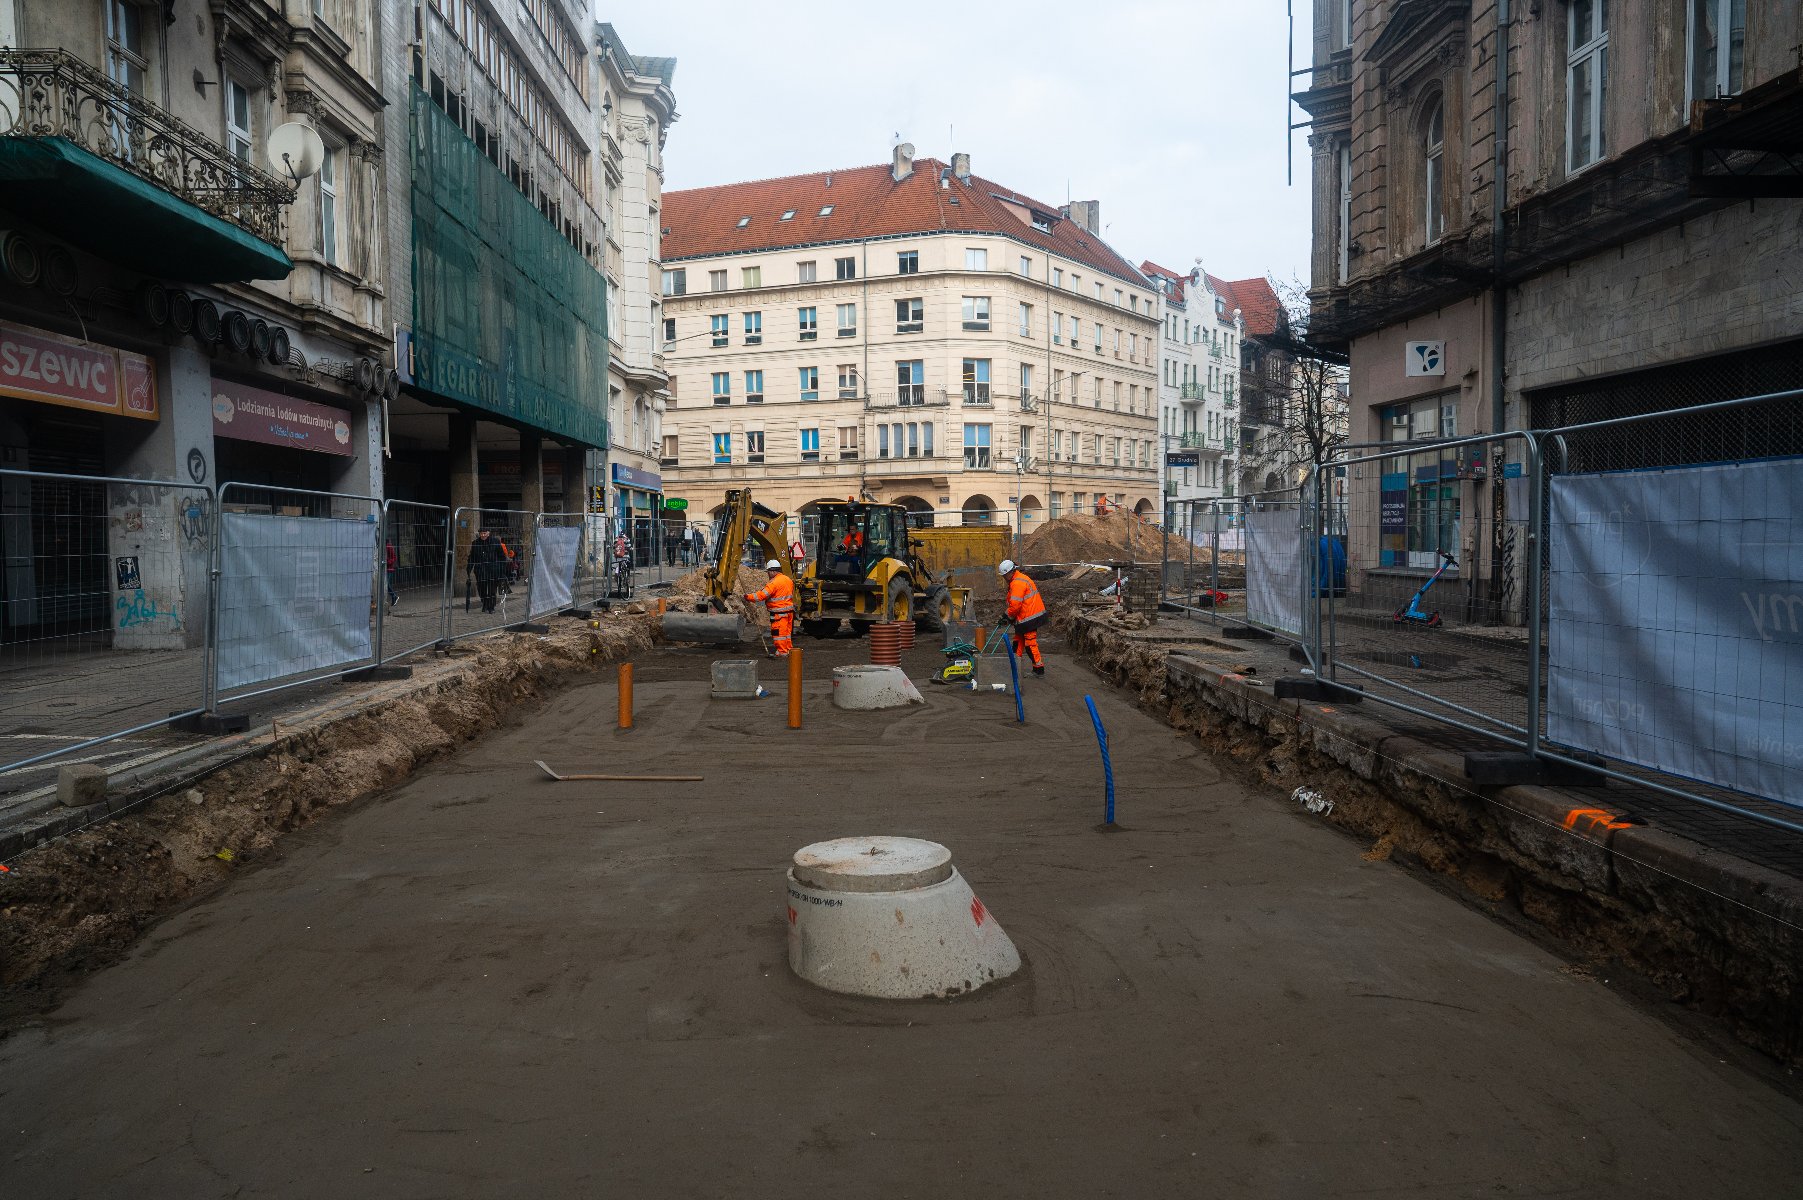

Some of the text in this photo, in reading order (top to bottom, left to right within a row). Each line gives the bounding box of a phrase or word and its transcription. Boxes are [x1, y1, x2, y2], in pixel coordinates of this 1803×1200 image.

[1, 340, 107, 394] szewc
[237, 397, 276, 420] Lodziarnia
[277, 406, 298, 424] lodów
[298, 413, 335, 433] naturalnych
